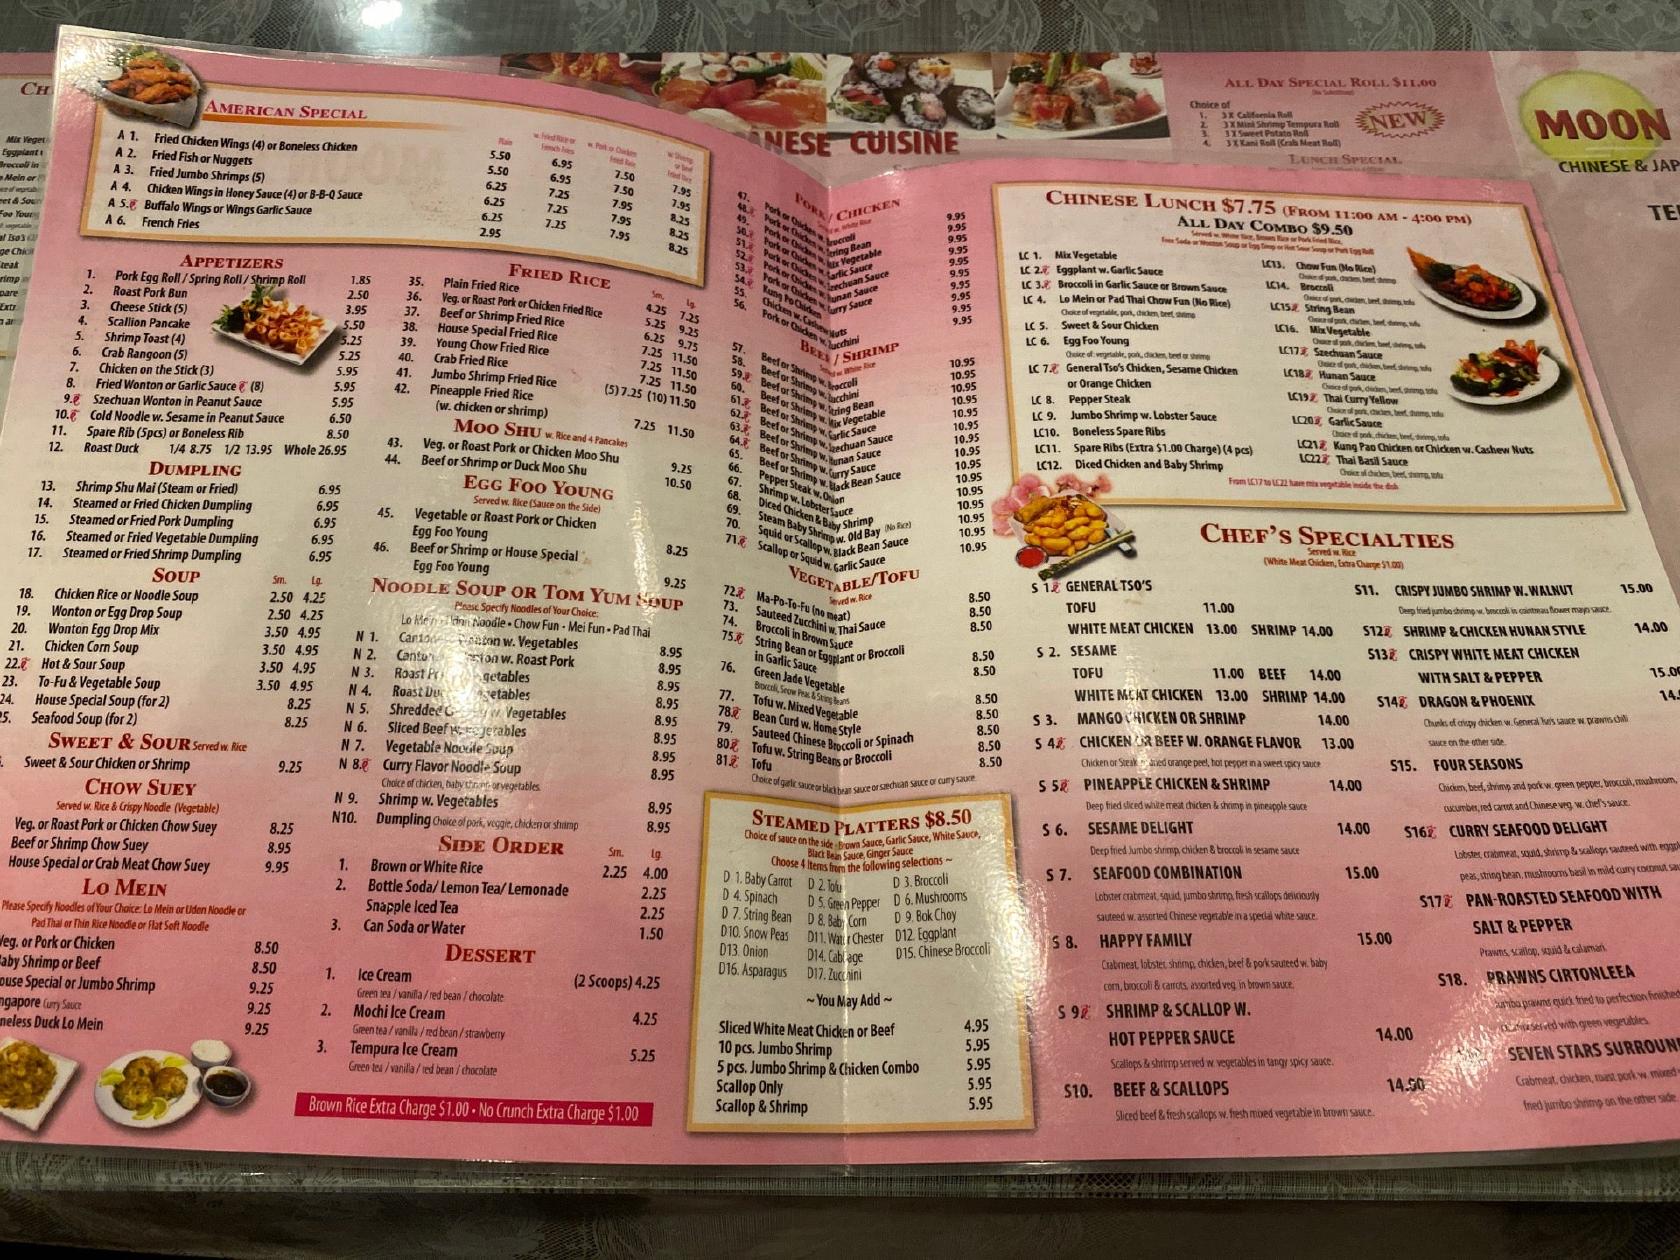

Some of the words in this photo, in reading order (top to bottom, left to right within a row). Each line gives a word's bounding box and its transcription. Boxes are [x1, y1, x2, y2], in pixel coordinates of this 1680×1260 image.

[1225, 79, 1254, 87] ALL
[1257, 78, 1283, 87] DAY
[1289, 77, 1346, 87] SPECIAL
[1350, 78, 1389, 87] ROLL
[204, 100, 295, 117] AMERICAN
[299, 106, 367, 119] SPECIAL
[1190, 101, 1219, 109] Choice
[1221, 101, 1230, 109] of
[1237, 111, 1276, 119] California
[1369, 111, 1426, 131] NEW
[1535, 108, 1671, 141] MOON
[117, 130, 124, 140] A
[130, 131, 138, 141] 1.
[155, 133, 179, 144] Fried
[182, 136, 218, 147] Chicken
[221, 138, 249, 151] Wings
[252, 140, 265, 151] (4)
[279, 141, 319, 151] Boneless
[322, 142, 357, 151] Chicken
[849, 129, 960, 155] CUISINE
[152, 150, 177, 160] Fried
[179, 151, 198, 162] Fish
[213, 154, 252, 167] Nuggets
[1288, 154, 1338, 164] LUNCH
[1342, 154, 1402, 164] SPECIAL
[1559, 159, 1631, 172] CHINESE
[1634, 158, 1648, 171] &
[490, 151, 510, 160] 5.50
[552, 159, 572, 169] 6.95
[615, 170, 634, 182] 7.50
[672, 185, 691, 197] 7.95
[1046, 190, 1138, 206] CHINESE
[1145, 194, 1215, 211] LUNCH
[1222, 198, 1276, 215] $7.75
[1283, 206, 1330, 218] (FROM
[1336, 211, 1373, 220] 11:00
[1378, 213, 1397, 221] AM
[1412, 214, 1442, 224] 4:00
[1446, 215, 1471, 224] PM)
[1178, 216, 1210, 228] ALL
[1215, 218, 1244, 230] DAY
[1250, 220, 1307, 234] COMBO
[1312, 223, 1353, 235] $9.50
[180, 255, 283, 269] APPETIZERS
[1019, 252, 1029, 260] LC
[1055, 251, 1071, 259] Mix
[1073, 251, 1117, 261] Vegetable
[444, 278, 468, 289] Plain
[472, 280, 497, 290] Fried
[499, 282, 519, 292] Rice
[508, 264, 563, 281] FRIED
[569, 271, 610, 289] RICE
[1089, 309, 1119, 317] vegetable,
[108, 317, 146, 327] Scallion
[149, 318, 190, 328] Pancake
[90, 410, 113, 420] Cold
[115, 411, 150, 422] Noodle
[153, 414, 163, 422] w.
[166, 411, 204, 422] Sesame
[207, 412, 216, 422] in
[219, 412, 253, 423] Peanut
[256, 412, 284, 423] Sauce
[330, 413, 351, 423] 6.50
[454, 419, 499, 434] MOO
[504, 422, 541, 438] SHU
[149, 462, 241, 476] DUMPLING
[463, 475, 502, 490] EGG
[508, 478, 547, 493] FOO
[553, 480, 613, 500] YOUNG
[1201, 523, 1292, 544] CHEF'S
[1299, 526, 1454, 550] SPECIALTIES
[152, 568, 200, 583] SOUP
[789, 564, 919, 592] VEGETABLE/TOFU
[1395, 585, 1430, 596] CRISPY
[1433, 586, 1468, 597] JUMBO
[1470, 586, 1511, 597] SHRIMP
[1513, 586, 1528, 596] W.
[1528, 585, 1573, 596] WALNUT
[1620, 584, 1653, 593] 15.00
[42, 658, 59, 669] Hot
[62, 658, 71, 669] &
[73, 658, 97, 669] Sour
[99, 659, 125, 673] Soup
[259, 661, 283, 673] 3.50
[292, 662, 316, 674] 4.95
[48, 732, 113, 748] SWEET
[118, 733, 134, 749] &
[140, 734, 190, 750] SOUR
[752, 758, 772, 771] Tofu
[980, 757, 1002, 767] 8.50
[86, 778, 142, 795] CHOW
[147, 779, 196, 796] SUEY
[753, 809, 831, 833] STEAMED
[834, 817, 919, 836] PLATTERS
[925, 809, 971, 829] $8.50
[439, 835, 485, 852] SIDE
[493, 837, 563, 855] ORDER
[1093, 866, 1151, 880] SEAFOOD
[1154, 866, 1242, 879] COMBINATION
[1346, 866, 1379, 879] 15.00
[82, 878, 109, 895] LO
[115, 879, 166, 896] MEIN
[894, 894, 900, 906] D
[905, 893, 913, 905] 6.
[916, 892, 967, 904] Mushrooms
[445, 944, 536, 963] DESSERT
[1541, 945, 1562, 956] squid
[1564, 944, 1571, 954] &
[817, 994, 835, 1007] You
[836, 995, 858, 1010] May
[860, 993, 880, 1006] Add
[354, 1004, 388, 1018] Mochi
[391, 1005, 406, 1018] Ice
[410, 1005, 445, 1019] Cream
[633, 1012, 657, 1025] 4.25
[717, 1079, 756, 1096] Scallop
[759, 1080, 783, 1096] Only
[968, 1077, 991, 1090] 5.95
[1114, 1082, 1145, 1097] BEEF
[1150, 1082, 1160, 1096] &
[1163, 1081, 1229, 1096] SCALLOPS
[309, 1097, 342, 1112] Brown
[346, 1098, 367, 1113] Rice
[370, 1098, 396, 1114] Extra
[400, 1099, 436, 1119] Charge
[439, 1101, 469, 1116] $1.00
[479, 1102, 493, 1117] No
[497, 1102, 533, 1118] Crunch
[537, 1103, 564, 1119] Extra
[568, 1104, 605, 1123] Charge
[608, 1104, 639, 1122] $1.00
